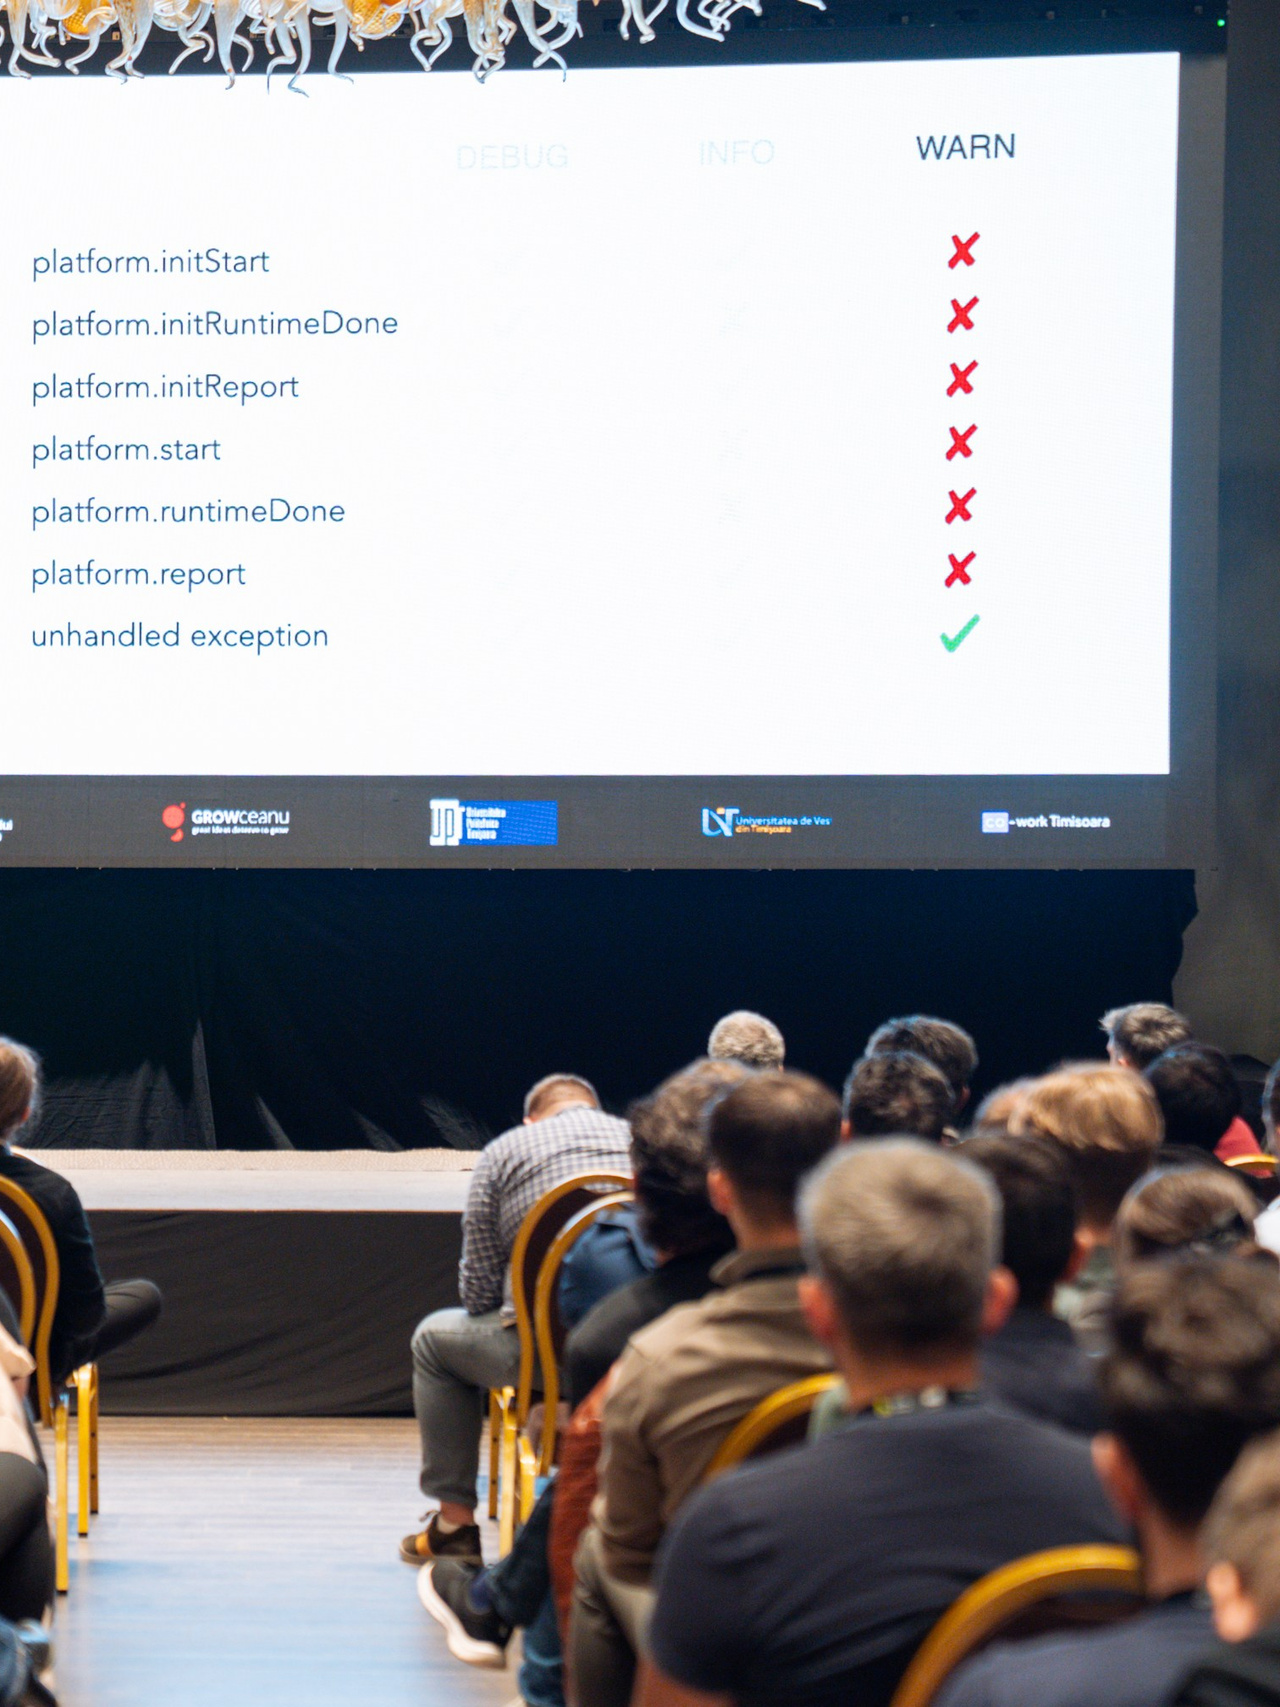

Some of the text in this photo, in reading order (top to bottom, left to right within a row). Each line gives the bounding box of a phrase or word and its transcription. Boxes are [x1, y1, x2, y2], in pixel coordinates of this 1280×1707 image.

[456, 143, 569, 170] DEBUG
[698, 138, 776, 166] INFO
[915, 132, 1017, 161] WARN
[33, 247, 270, 282] platform.initStart
[33, 310, 399, 345] platform.initRuntimeDone
[33, 373, 300, 407] platform.initReport
[32, 435, 222, 469] platform.start
[32, 497, 346, 532] platform.runtimeDone
[32, 560, 247, 594] platform.report
[32, 622, 329, 656] unhandled exception
[191, 809, 290, 824] GROWceanu
